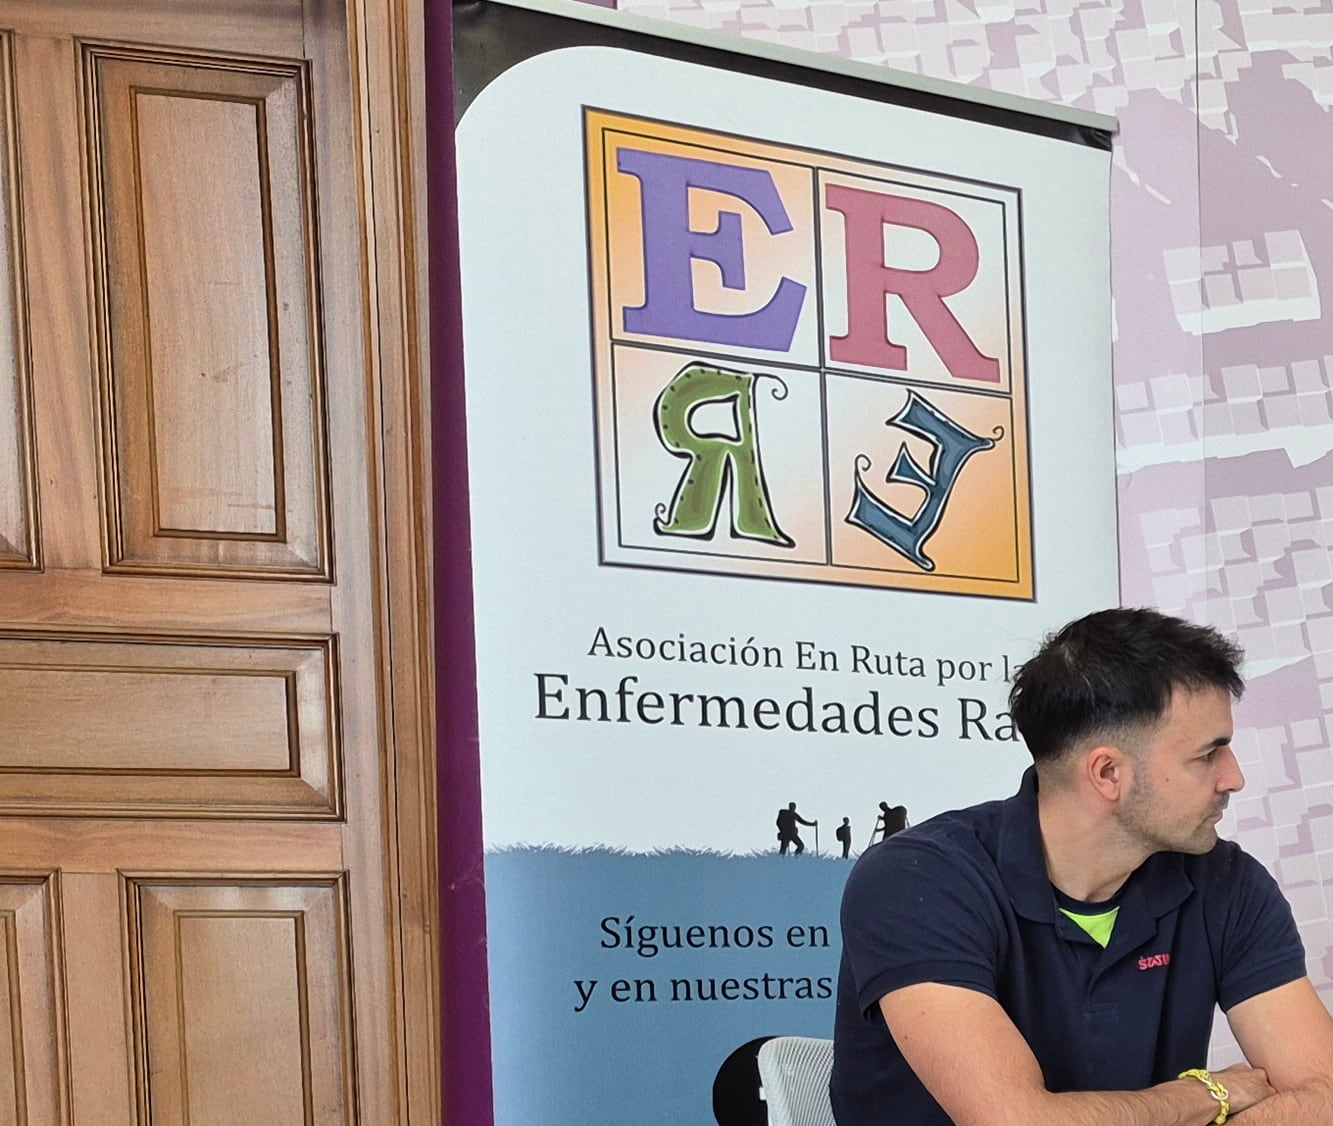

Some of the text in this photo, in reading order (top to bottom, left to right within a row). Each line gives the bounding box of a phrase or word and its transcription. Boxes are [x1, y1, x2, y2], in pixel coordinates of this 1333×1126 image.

[587, 626, 784, 669] Asociación
[795, 640, 840, 672] En
[851, 644, 926, 679] Ruta
[937, 653, 993, 686] por
[533, 672, 939, 739] Enfermedades
[599, 915, 830, 957] Síguenos en
[574, 973, 833, 1012] y en nuestras
